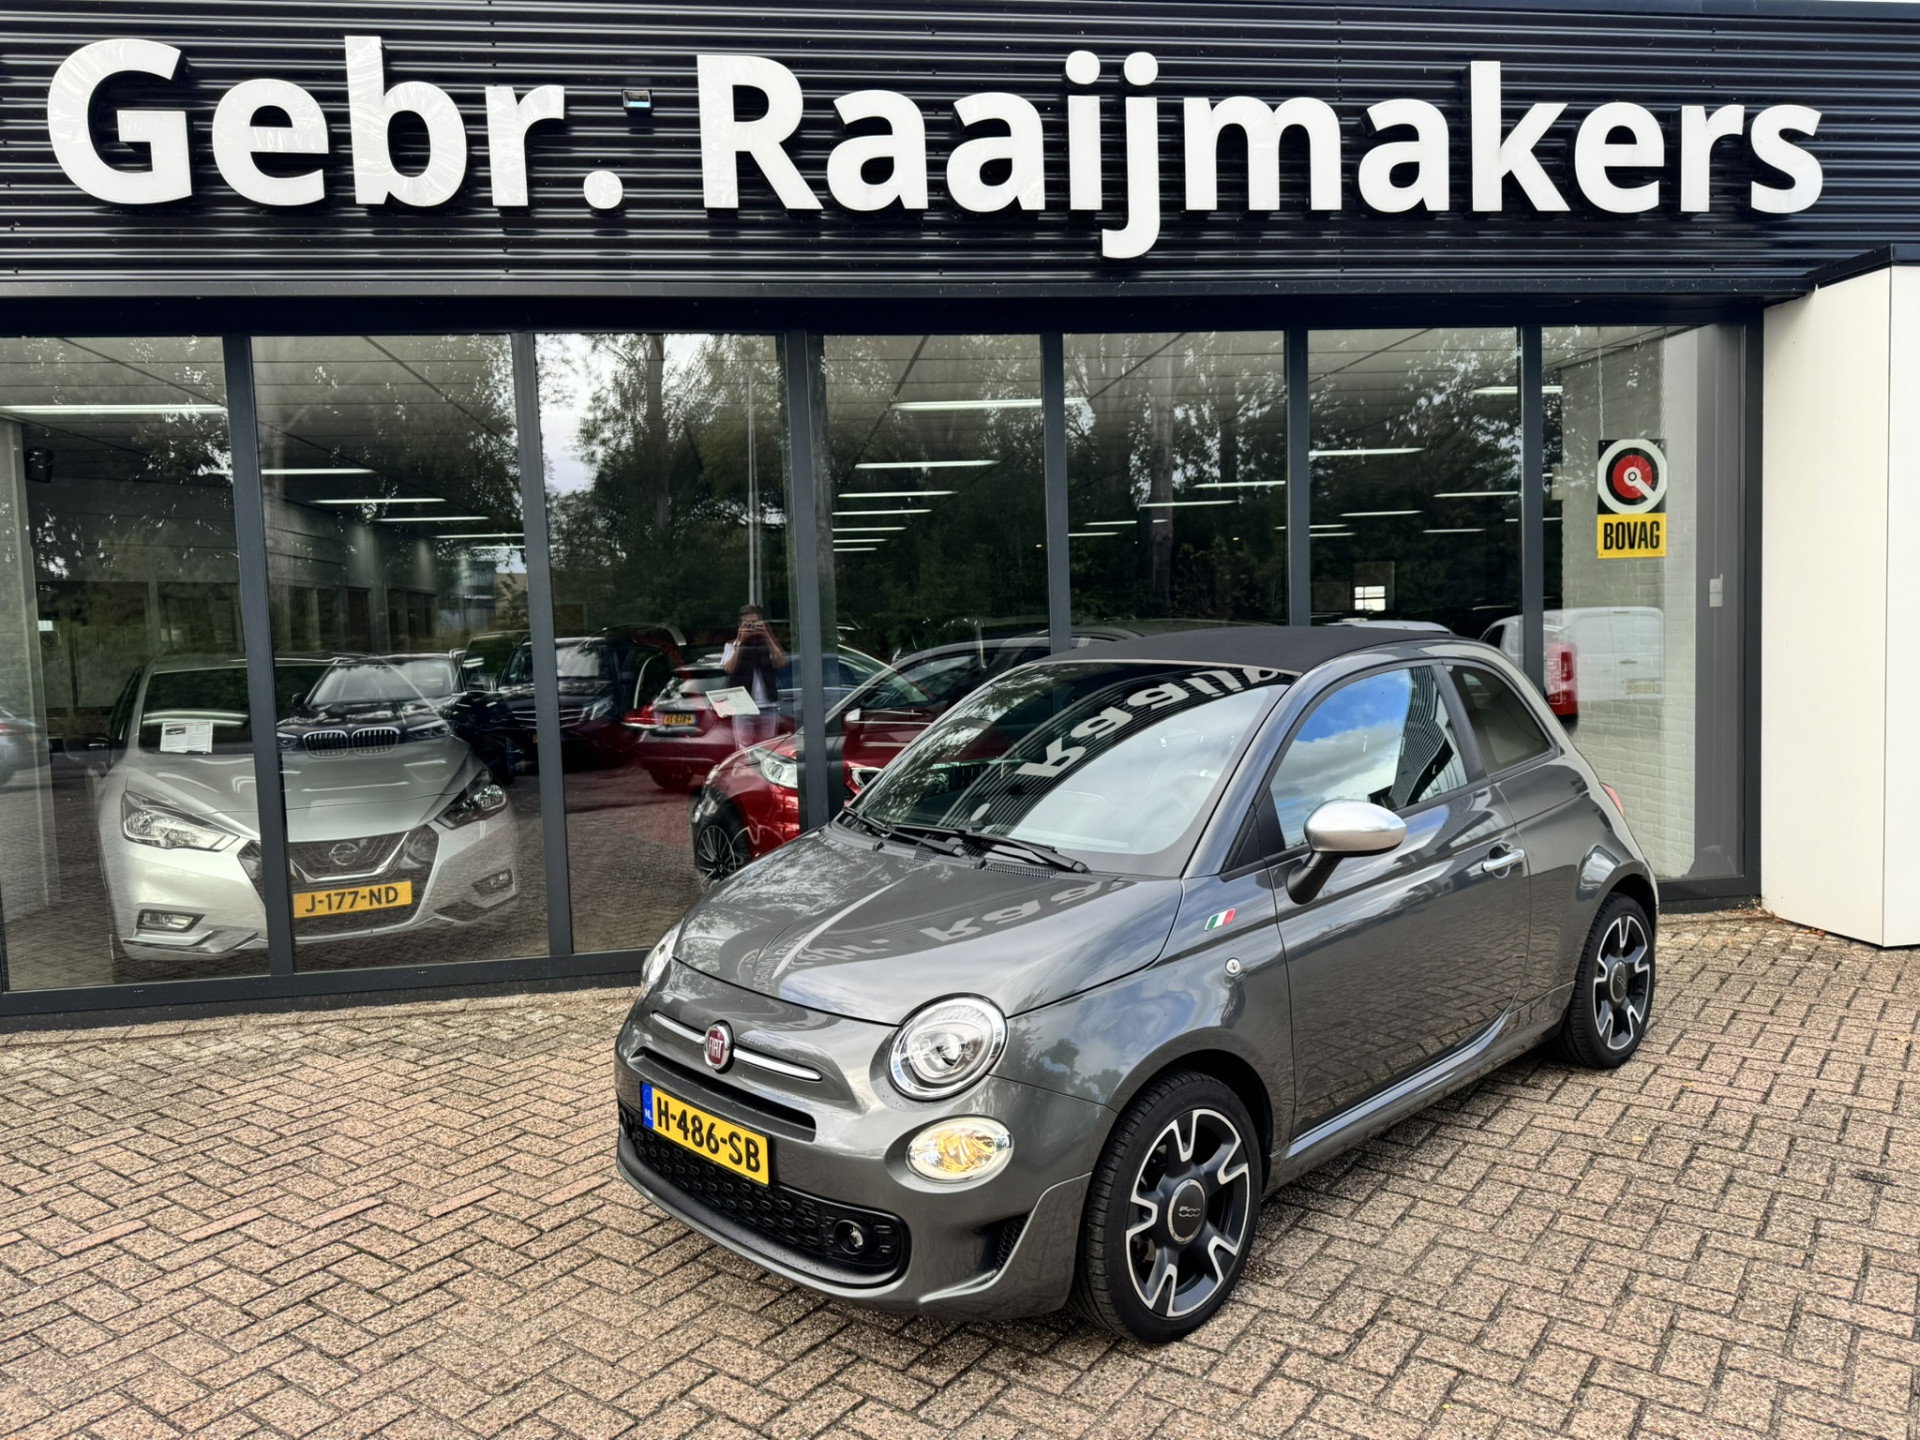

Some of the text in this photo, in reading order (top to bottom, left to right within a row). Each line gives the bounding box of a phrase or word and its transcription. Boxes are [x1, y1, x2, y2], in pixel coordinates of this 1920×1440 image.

[47, 35, 1823, 258] Gebr. Raaijmakers
[1603, 520, 1660, 550] BOVAG
[305, 886, 399, 913] J-177-ND
[708, 1036, 723, 1059] FIAT
[656, 1096, 761, 1173] H-486-SB
[1178, 1205, 1201, 1218] 500
